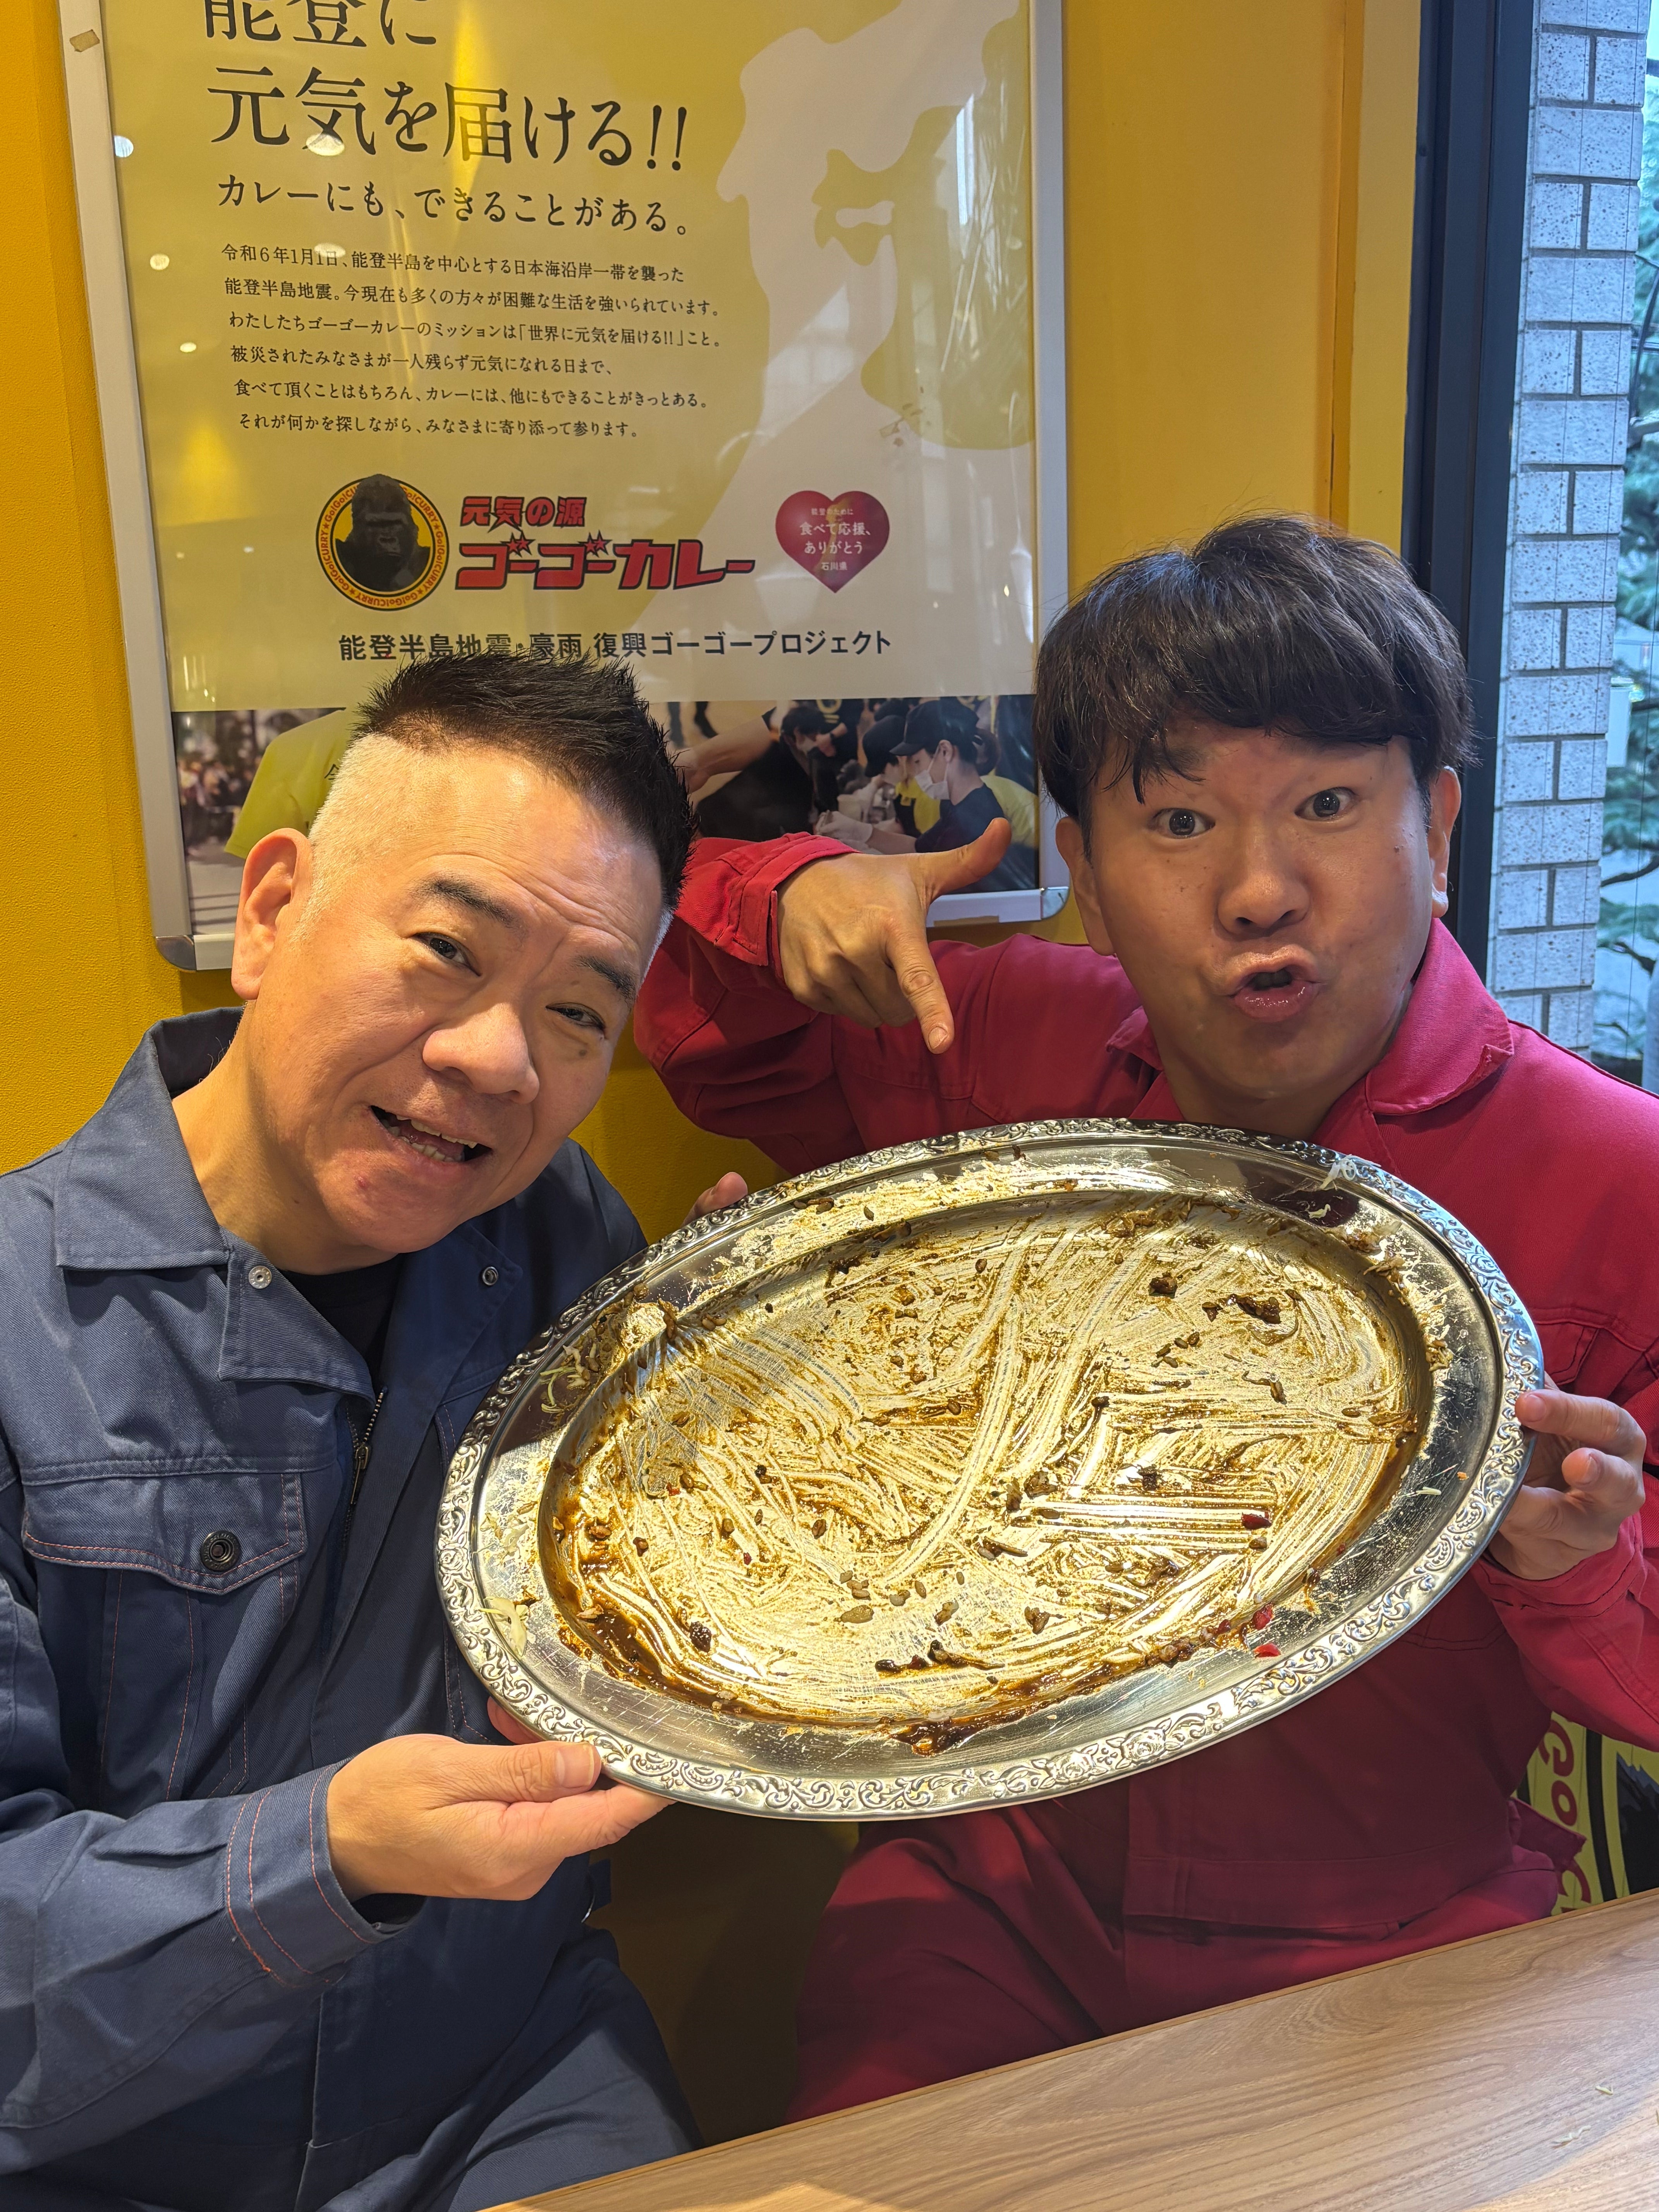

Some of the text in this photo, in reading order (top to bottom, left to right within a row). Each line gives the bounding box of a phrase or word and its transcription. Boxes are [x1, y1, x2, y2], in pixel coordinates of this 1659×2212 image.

[218, 174, 687, 235] カレーにも、できることがある。
[225, 278, 718, 316] 能登半島地震。今現在も多くの方々が困難な生活を強いられています。
[231, 345, 611, 375] 被災されたみなさまが一人残らず元気になれる日まで、
[234, 378, 707, 408] 食べて頂くことはもちろん、カレーには、他にもできることがきっとある。
[239, 413, 637, 438] それが何かを探しながら、みなさまに寄り添って参ります。
[460, 496, 587, 533] 元気の源
[800, 522, 871, 535] 食べて応援、
[455, 530, 755, 590] ゴーゴーカレー
[804, 541, 863, 554] ありがとう
[821, 562, 848, 570] 石川県
[593, 630, 891, 659] 復興ゴーゴープロジェクト
